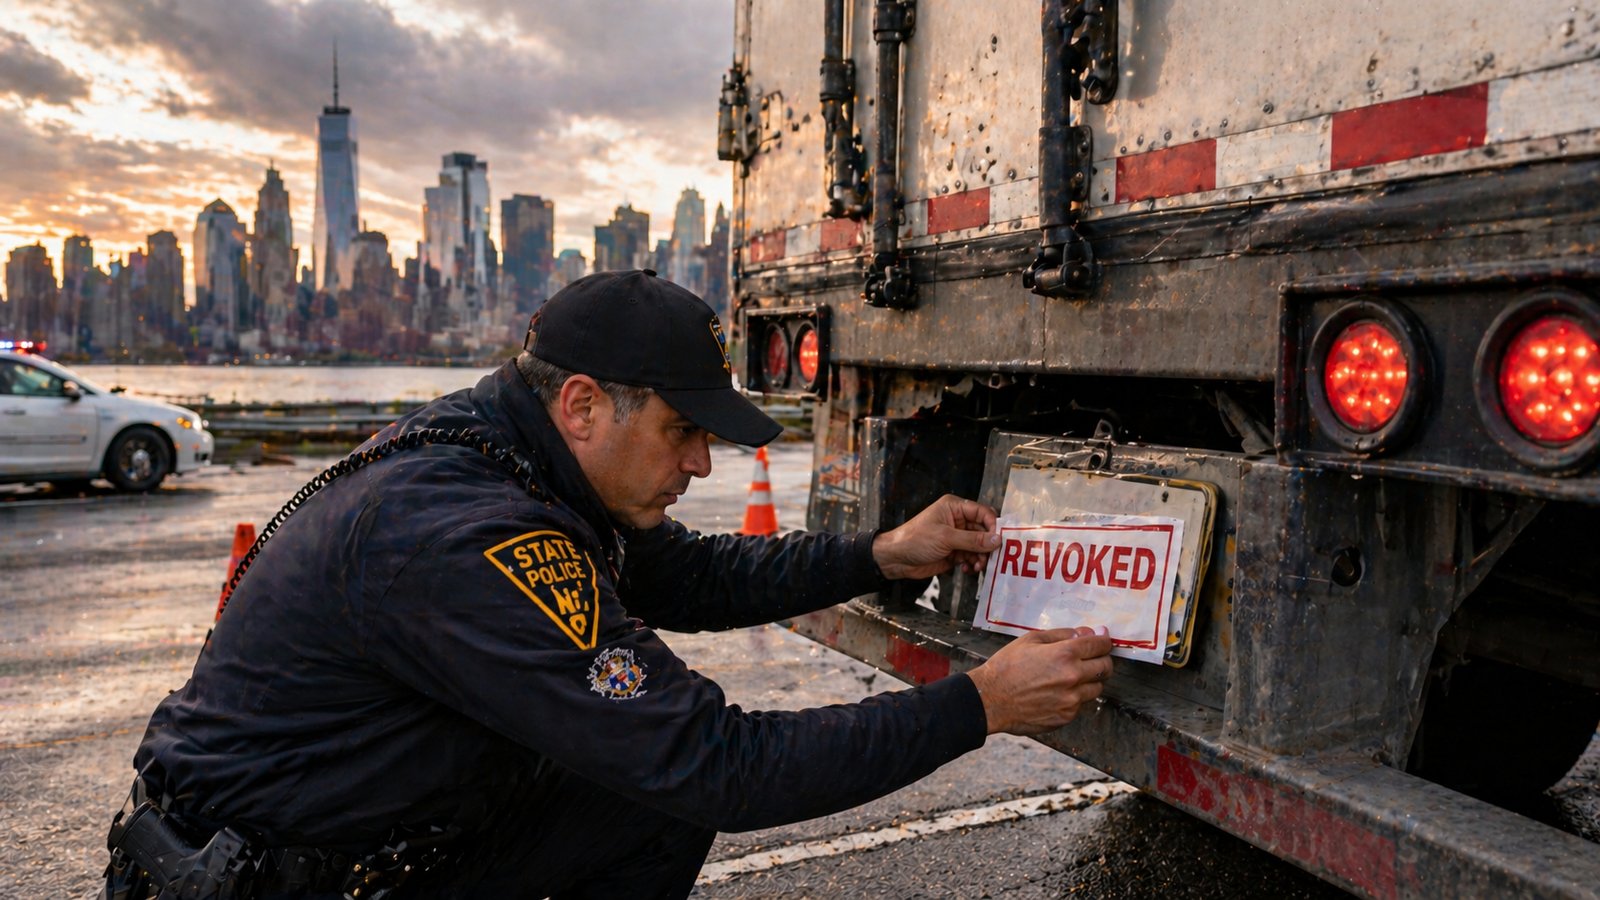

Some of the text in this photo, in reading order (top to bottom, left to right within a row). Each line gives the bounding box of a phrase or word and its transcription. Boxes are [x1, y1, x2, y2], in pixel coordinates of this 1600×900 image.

[513, 539, 581, 568] STATE
[1000, 538, 1156, 591] REVOKED
[525, 561, 587, 588] POLICE
